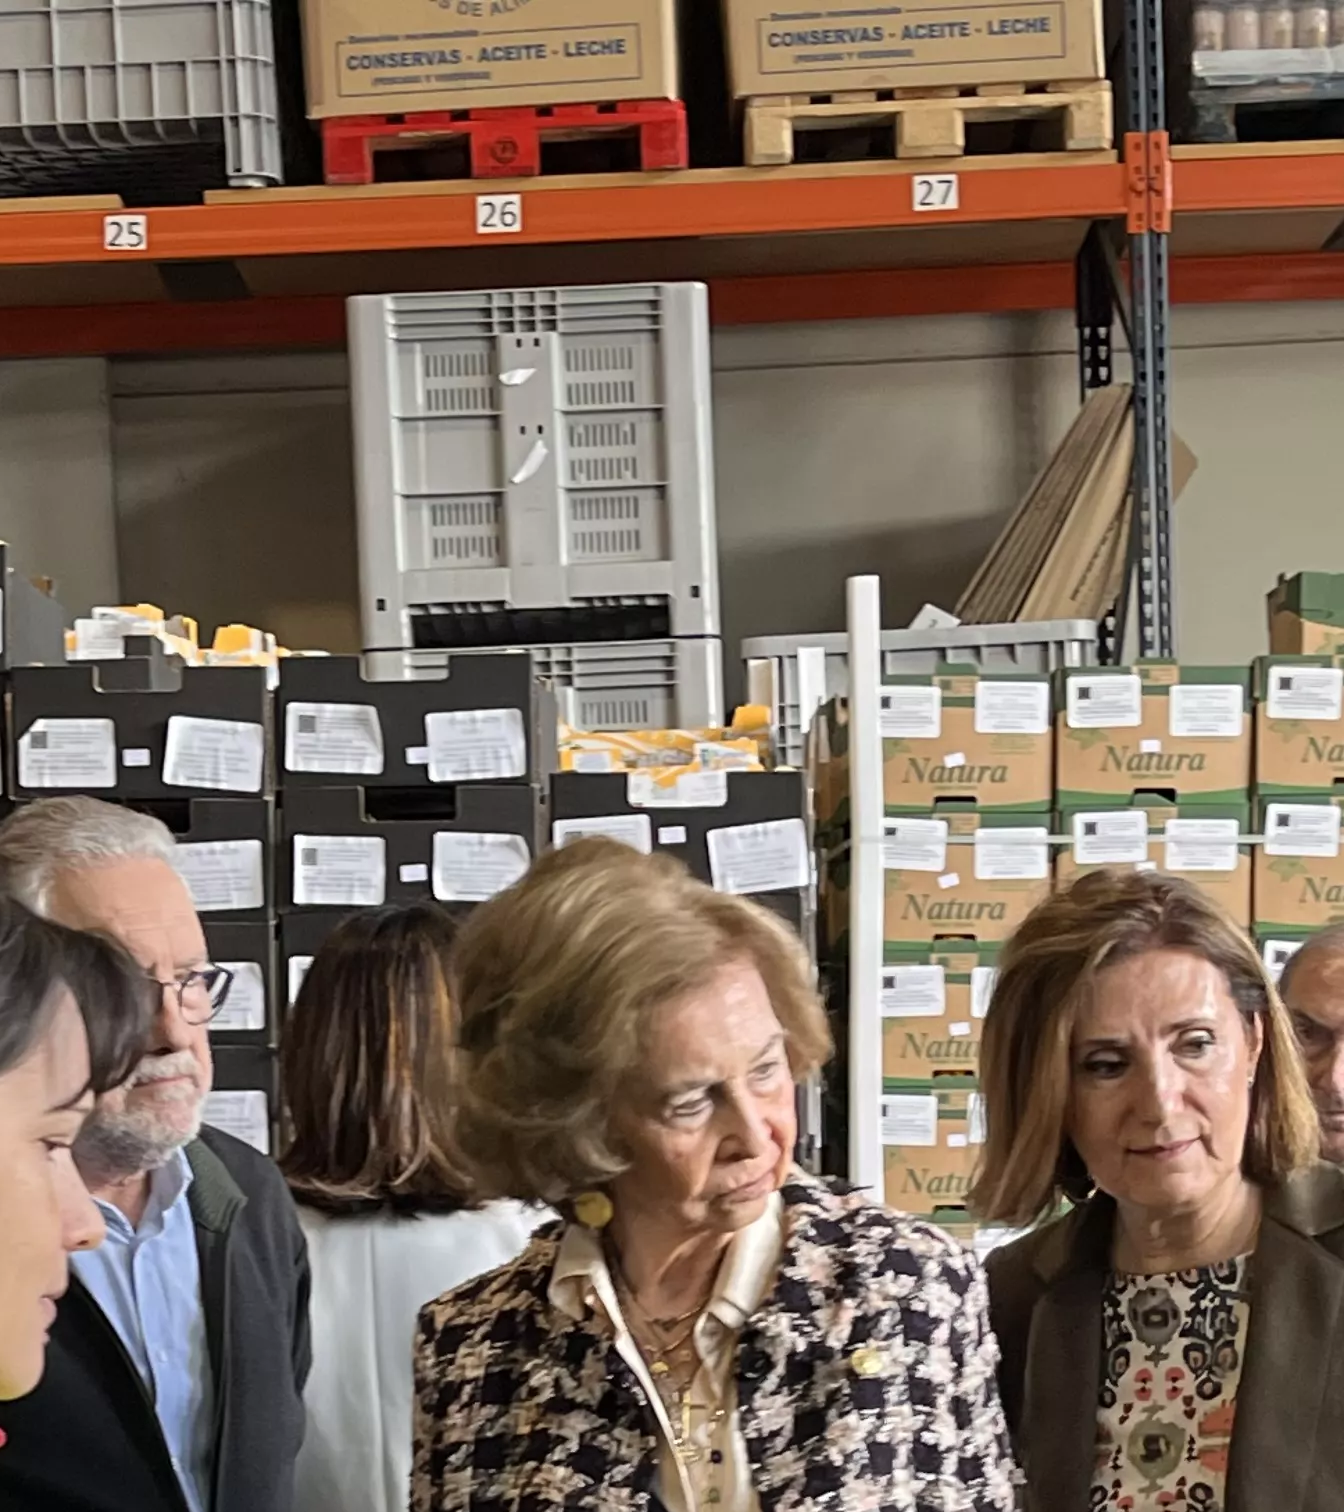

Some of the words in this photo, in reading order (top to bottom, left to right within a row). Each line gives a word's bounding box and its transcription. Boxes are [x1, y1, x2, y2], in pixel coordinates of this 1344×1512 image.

[768, 26, 884, 48] CONSERVAS
[901, 21, 970, 41] ACEITE
[987, 17, 1051, 36] LECHE
[346, 49, 461, 70] CONSERVAS
[477, 44, 546, 63] ACEITE
[563, 39, 626, 57] LECHE
[917, 180, 954, 206] 27
[481, 201, 517, 227] 26
[107, 221, 143, 247] 25
[902, 757, 1008, 784] Natura
[1098, 745, 1206, 772] Natura
[900, 893, 1007, 920] Natura
[900, 1032, 980, 1058] Natu
[900, 1168, 973, 1193] Natu
